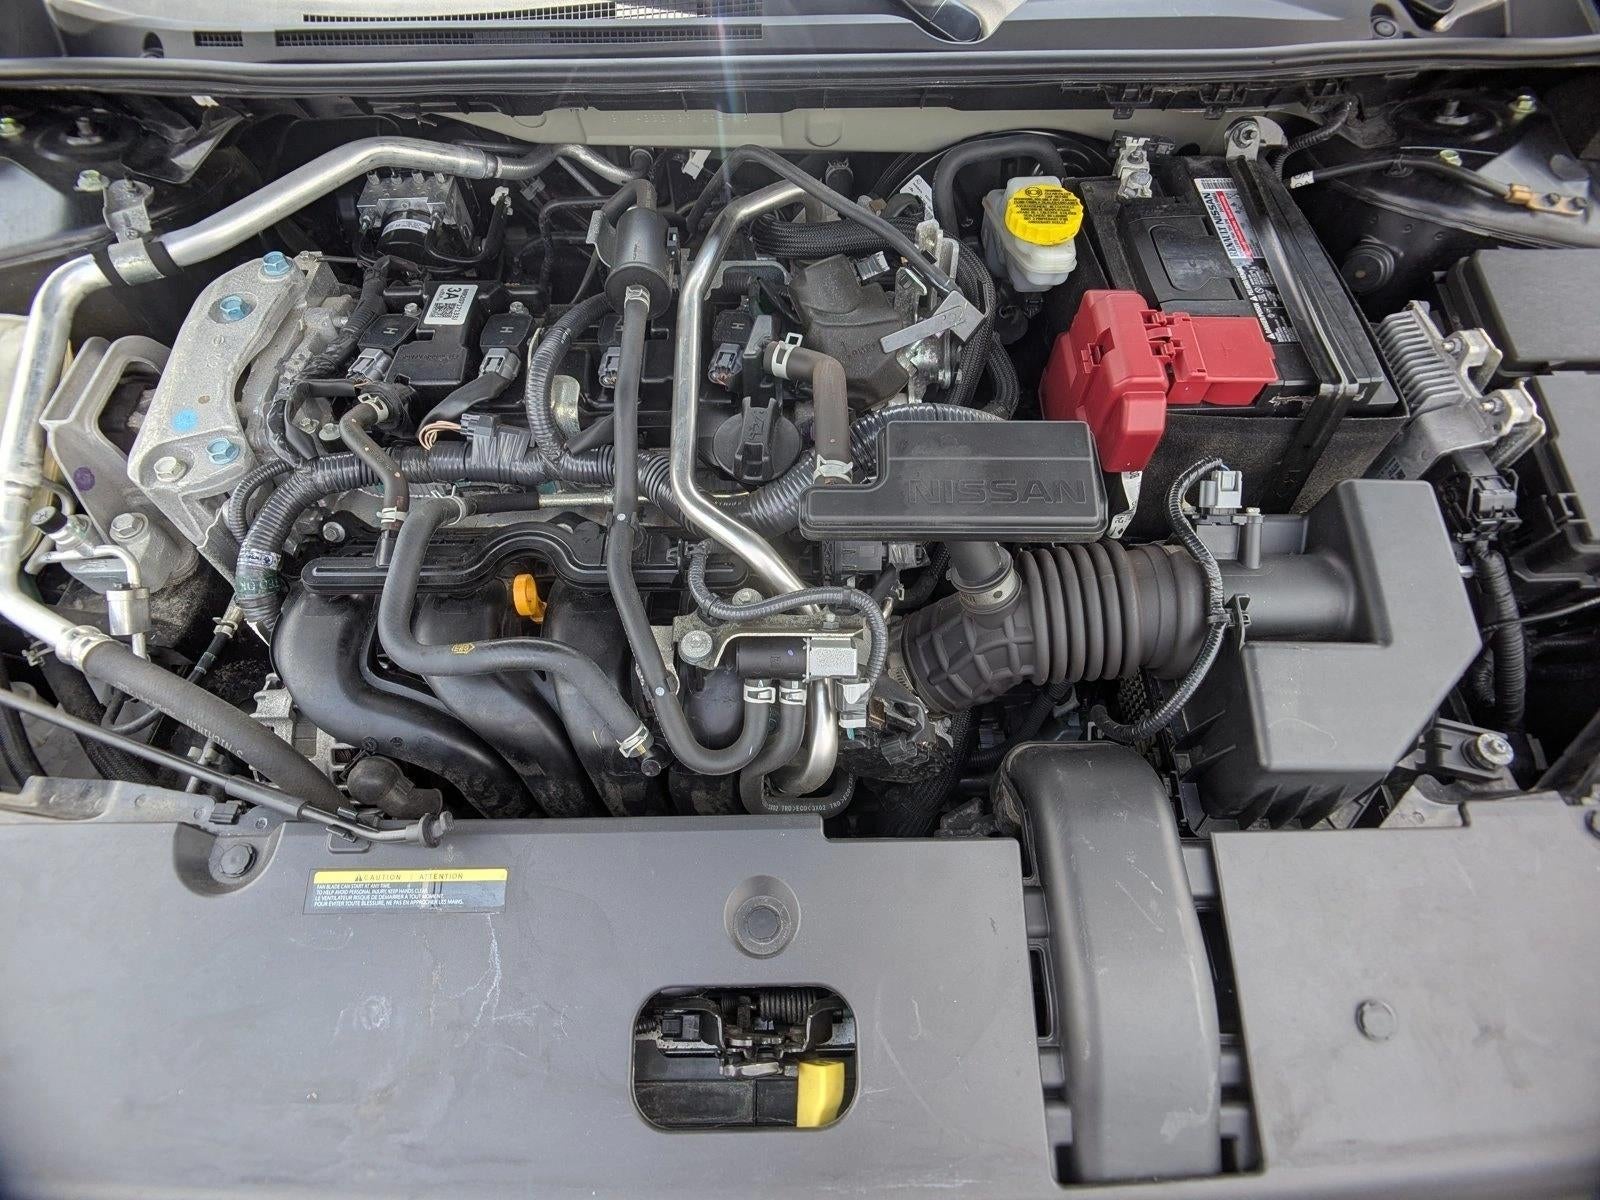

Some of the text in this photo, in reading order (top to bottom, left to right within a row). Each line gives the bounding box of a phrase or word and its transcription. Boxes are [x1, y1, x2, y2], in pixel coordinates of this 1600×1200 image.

[1203, 192, 1222, 225] NISSAN
[1218, 226, 1239, 258] RENAULT
[443, 287, 462, 300] 3A
[906, 478, 1088, 505] NISSAN
